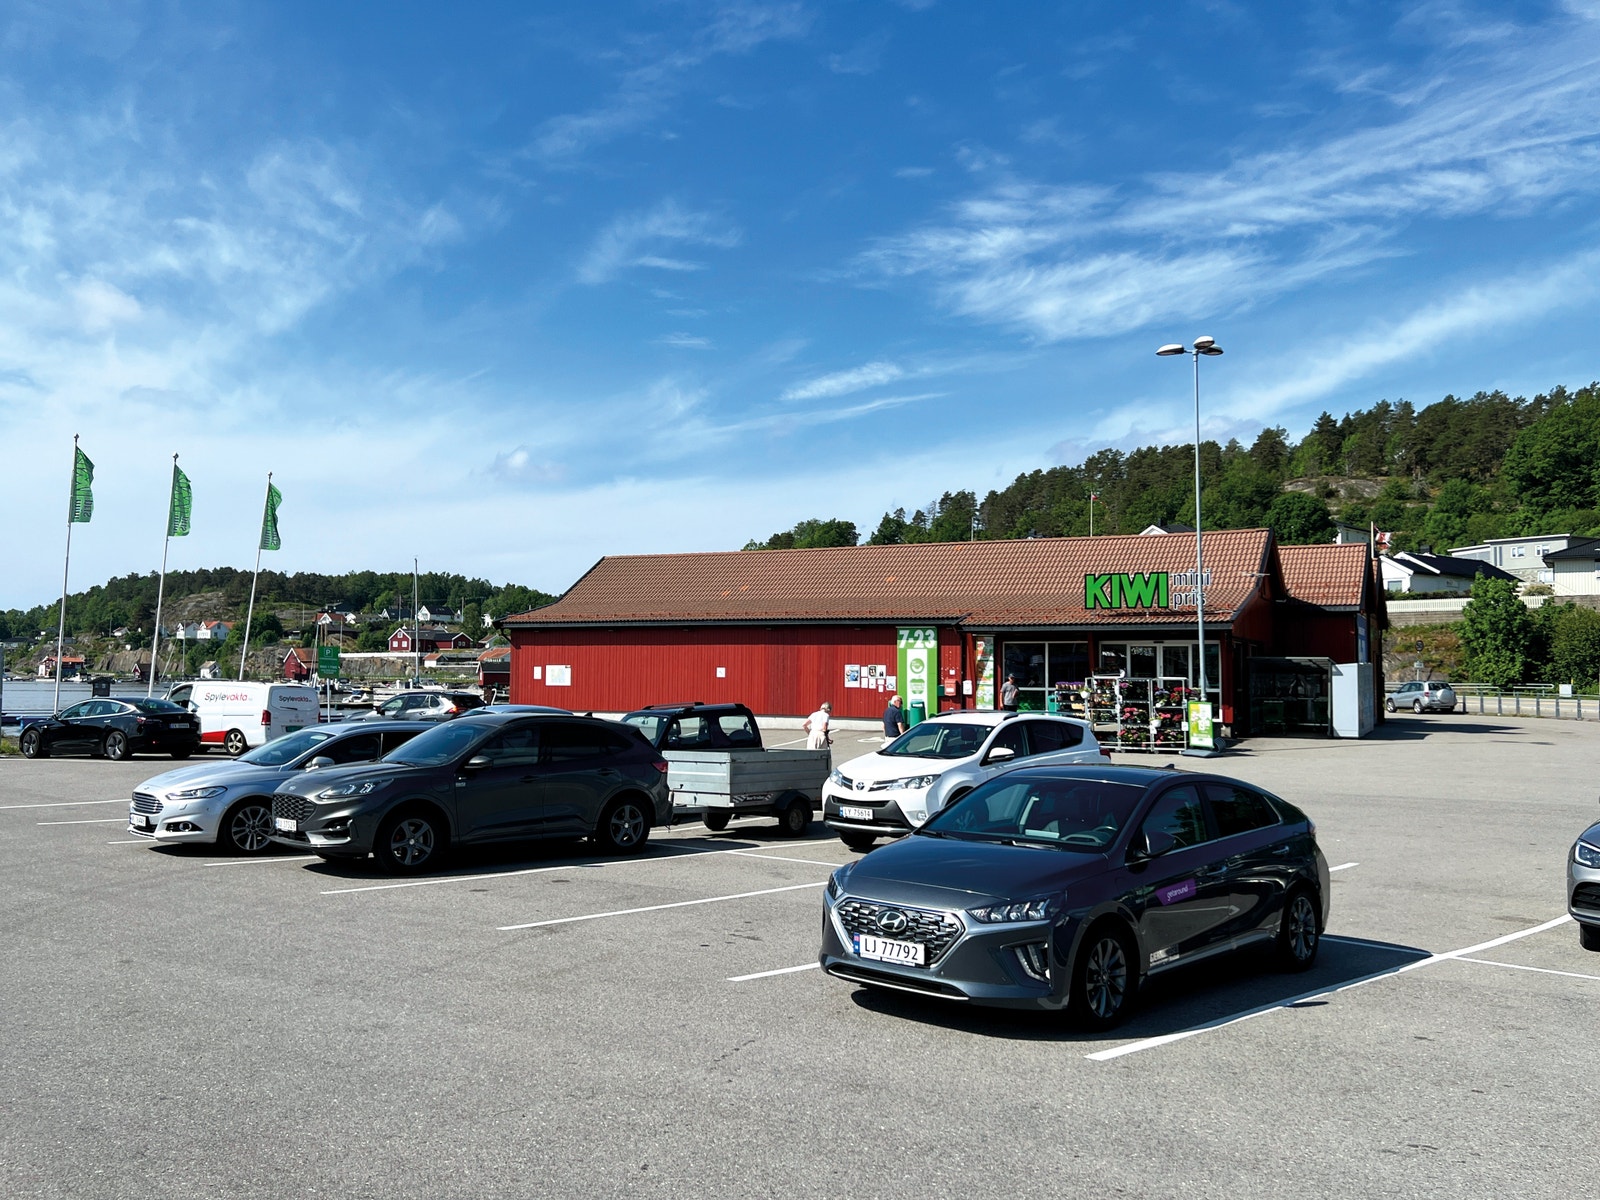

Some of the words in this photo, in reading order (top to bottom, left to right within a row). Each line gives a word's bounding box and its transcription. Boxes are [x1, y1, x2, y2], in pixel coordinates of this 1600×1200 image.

[1173, 568, 1211, 586] mini
[1084, 571, 1169, 609] KIWI
[899, 629, 935, 648] 7-23
[204, 692, 248, 702] Spylevakta
[1166, 884, 1189, 901] getaround
[864, 938, 876, 953] LJ
[881, 941, 918, 960] 77792
